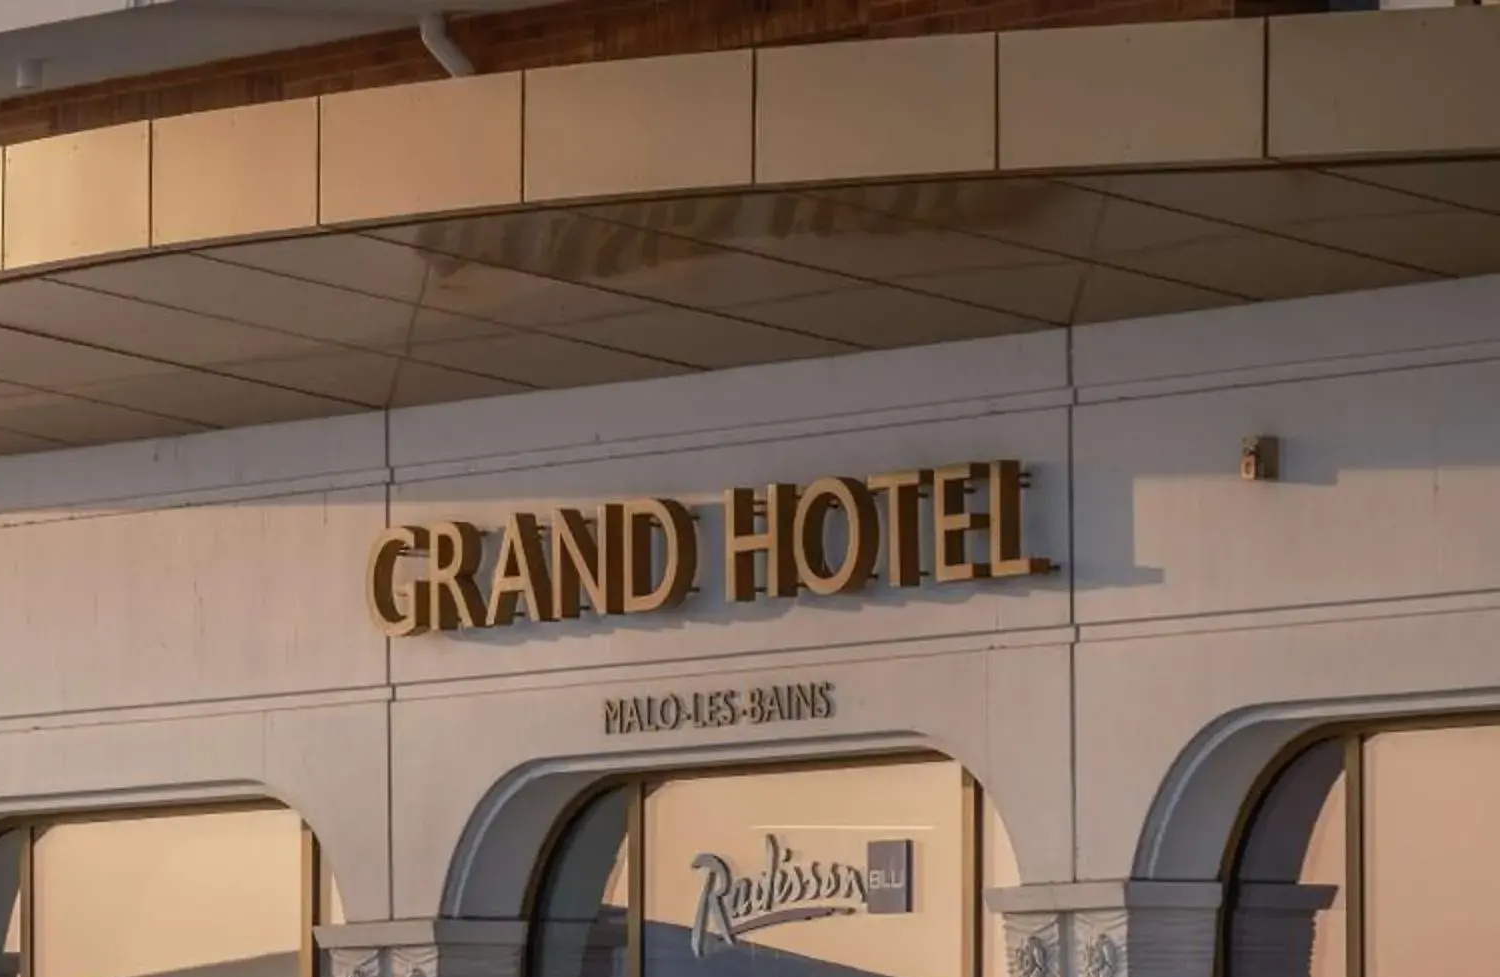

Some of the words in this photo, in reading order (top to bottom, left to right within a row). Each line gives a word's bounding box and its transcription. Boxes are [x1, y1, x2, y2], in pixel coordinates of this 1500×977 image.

[366, 498, 698, 637] GRAND
[725, 459, 1052, 602] HOTEL
[691, 833, 868, 958] Radisson
[868, 866, 905, 890] BLU
